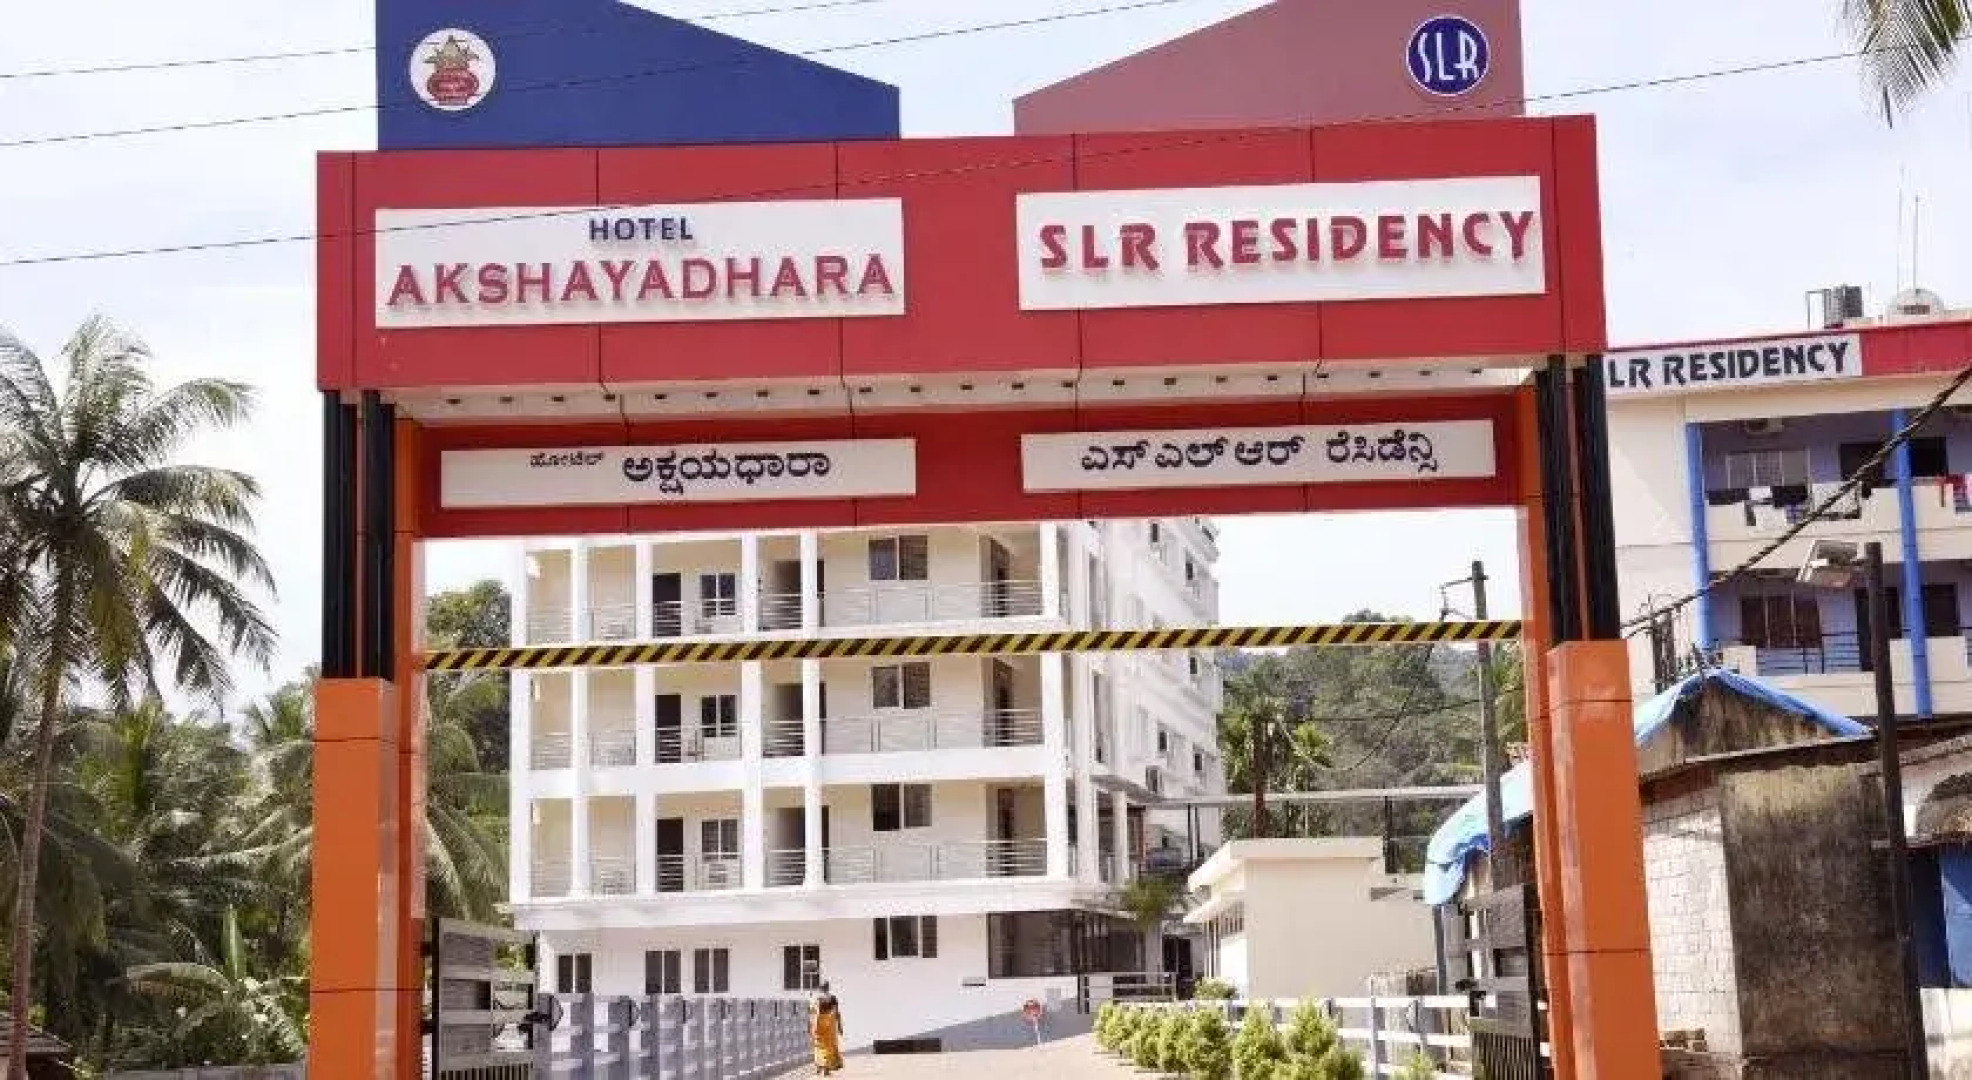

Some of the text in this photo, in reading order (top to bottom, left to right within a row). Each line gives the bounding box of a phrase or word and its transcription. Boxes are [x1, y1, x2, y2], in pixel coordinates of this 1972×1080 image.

[1417, 30, 1479, 83] SLR
[588, 217, 694, 241] HOTEL
[1040, 211, 1534, 270] SLR RESIDENCY
[388, 253, 895, 306] AKSHAYADHARA
[1662, 341, 1849, 387] RESIDENCY
[622, 449, 831, 495] ಅಕ್ಷಯಧಾರಾ
[1326, 429, 1438, 473] ರೆಸಿಡೆನ್ಸಿ
